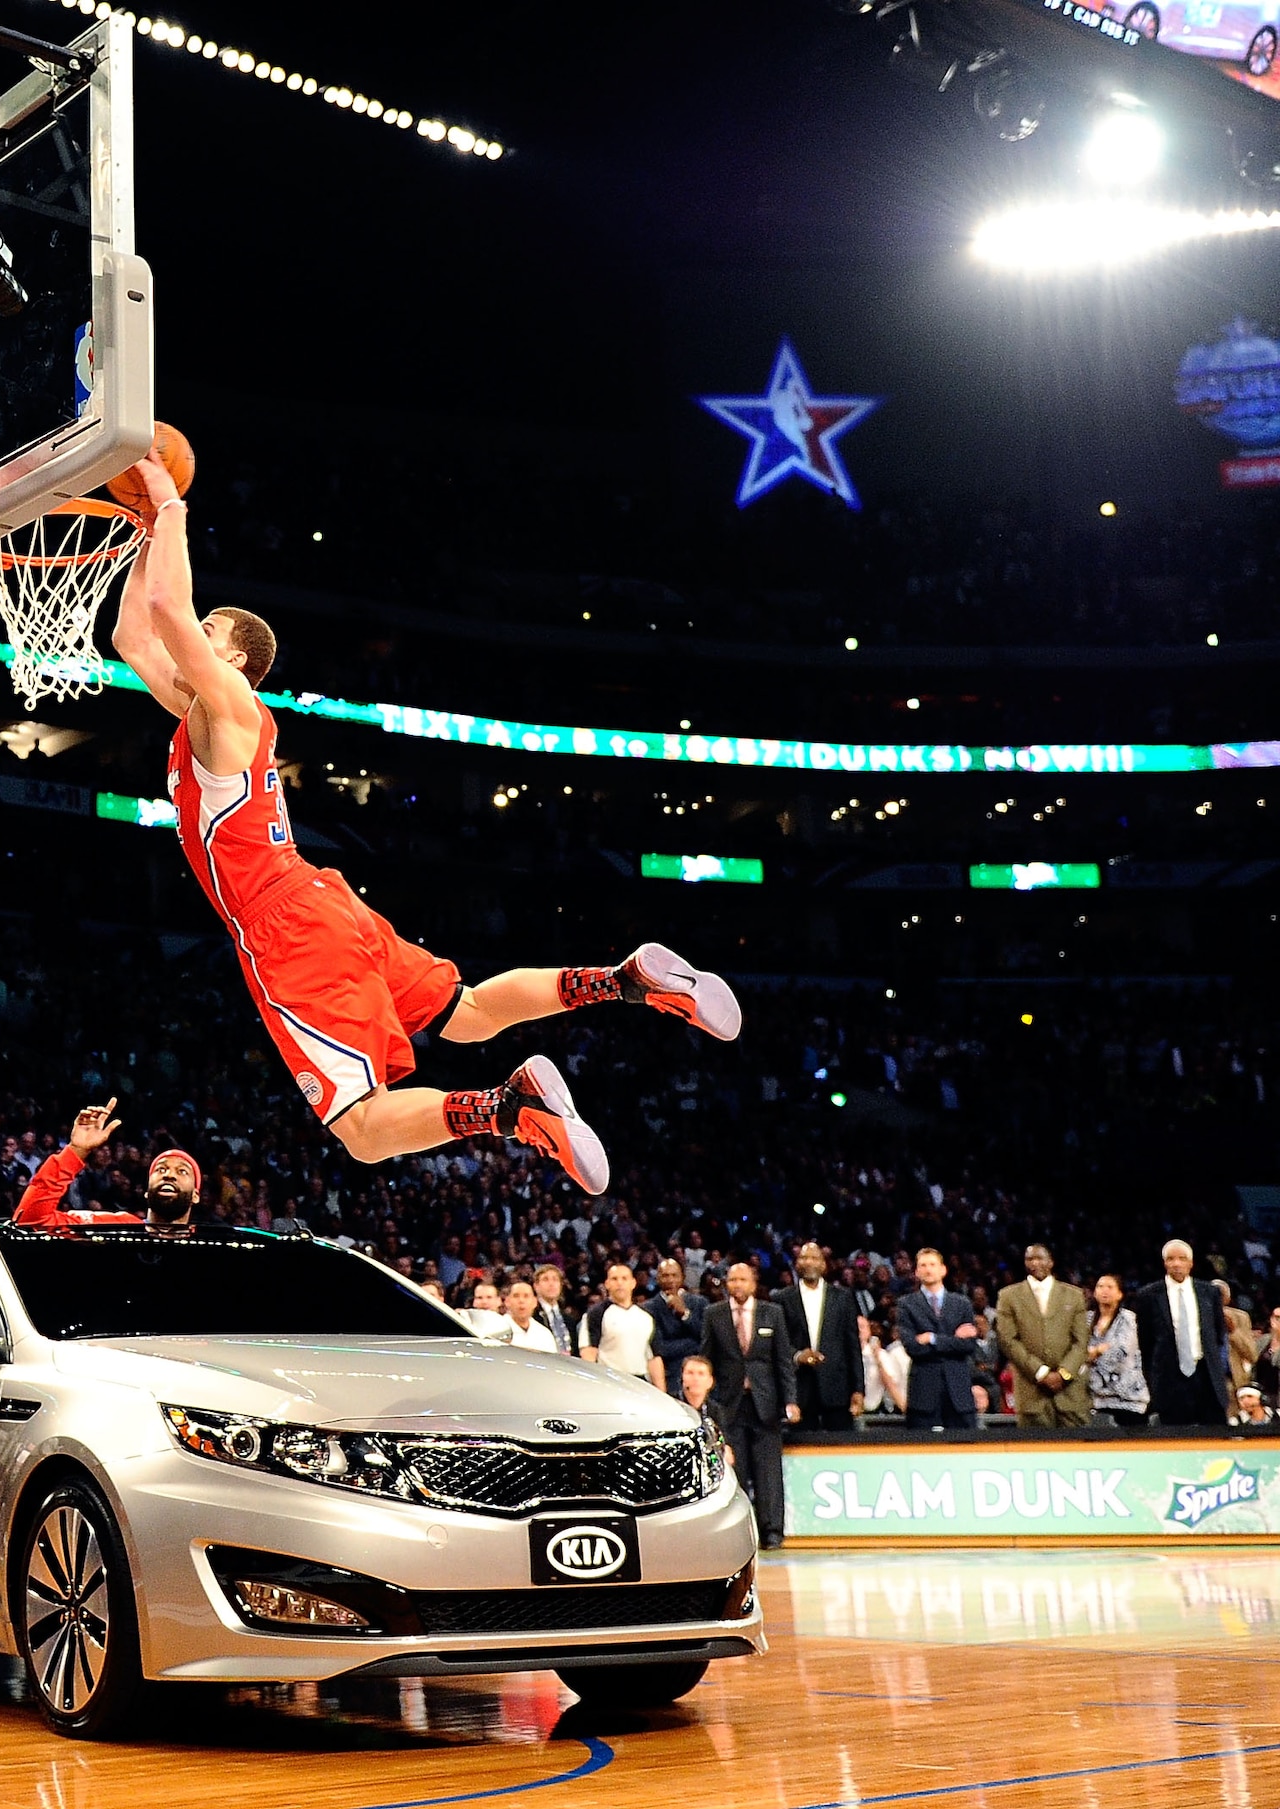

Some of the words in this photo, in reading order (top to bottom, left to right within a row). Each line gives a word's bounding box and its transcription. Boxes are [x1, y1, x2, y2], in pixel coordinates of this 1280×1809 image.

[376, 703, 475, 742] TEXT
[486, 720, 511, 748] A
[522, 731, 560, 752] or
[609, 735, 648, 758] to
[794, 742, 971, 772] (DUNKS)
[983, 744, 1133, 772] NOW!!!
[811, 1469, 957, 1519] SLAM
[970, 1468, 1133, 1518] DUNK
[1172, 1472, 1257, 1521] Sprite
[560, 1538, 614, 1566] KIA
